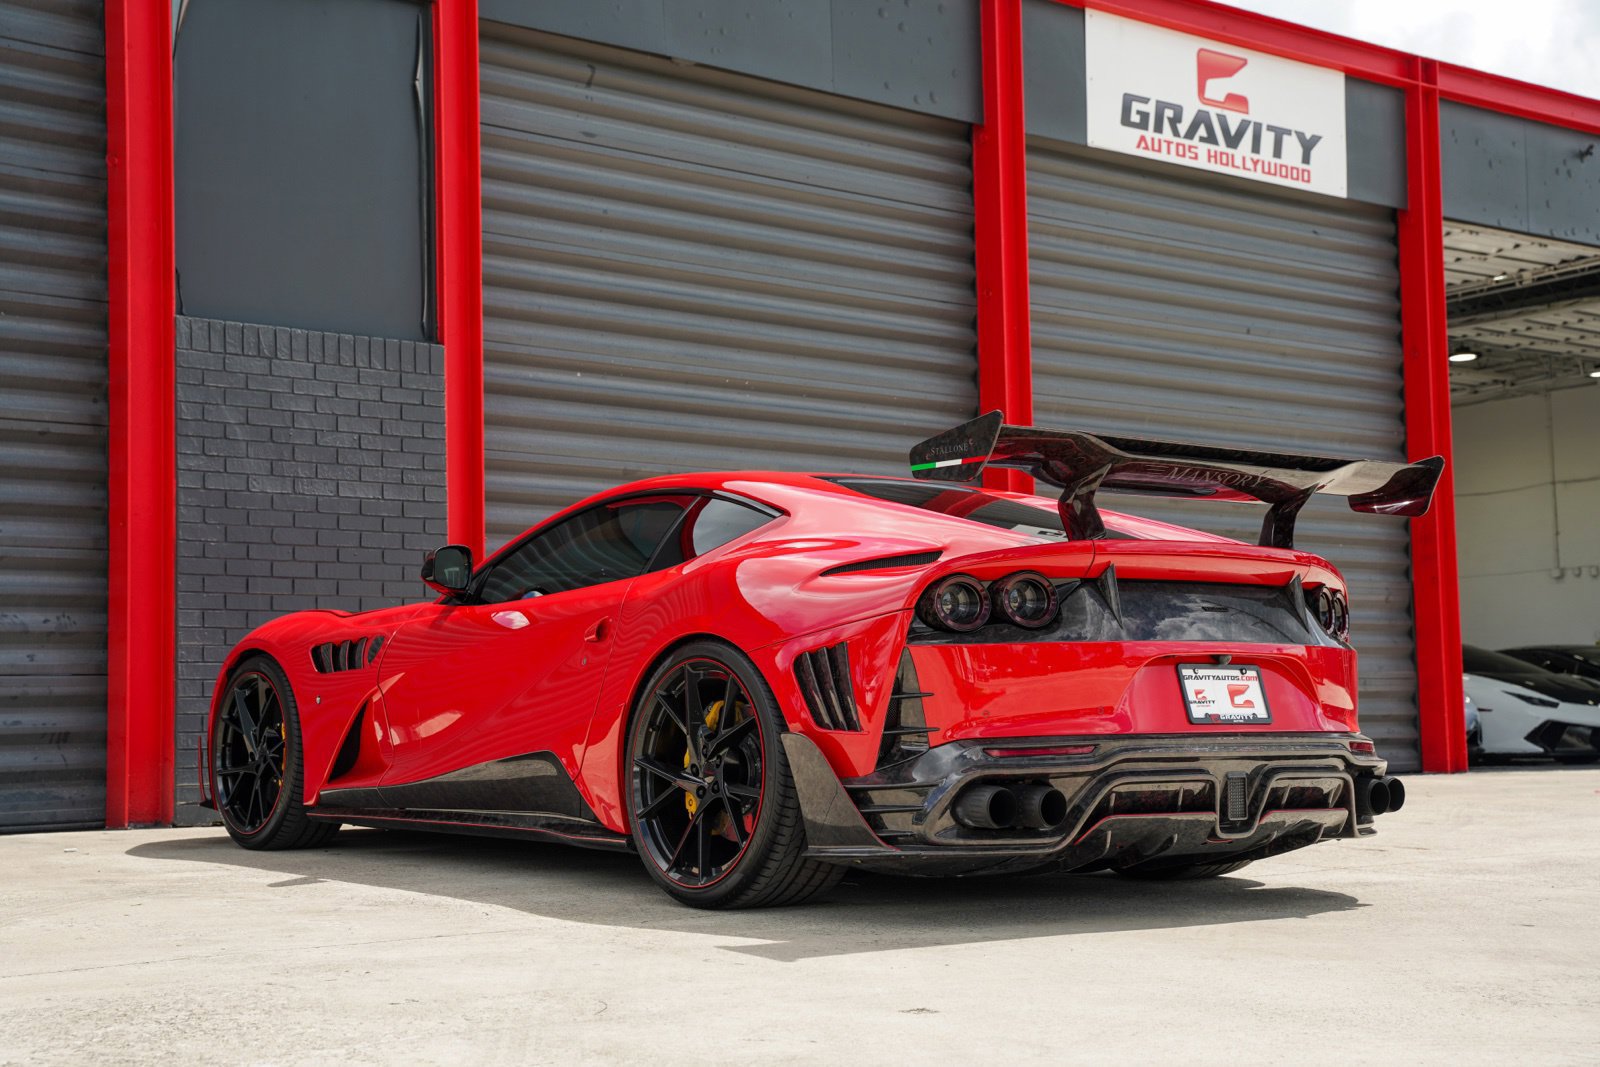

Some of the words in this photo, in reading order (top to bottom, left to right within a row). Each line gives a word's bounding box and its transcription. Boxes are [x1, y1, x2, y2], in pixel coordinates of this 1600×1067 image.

[1120, 92, 1323, 166] GRAVITY
[1136, 134, 1199, 161] AUTOS
[1207, 148, 1312, 184] HOLLYWOOD
[930, 443, 969, 456] STALLONE
[1164, 466, 1271, 489] MANSORY
